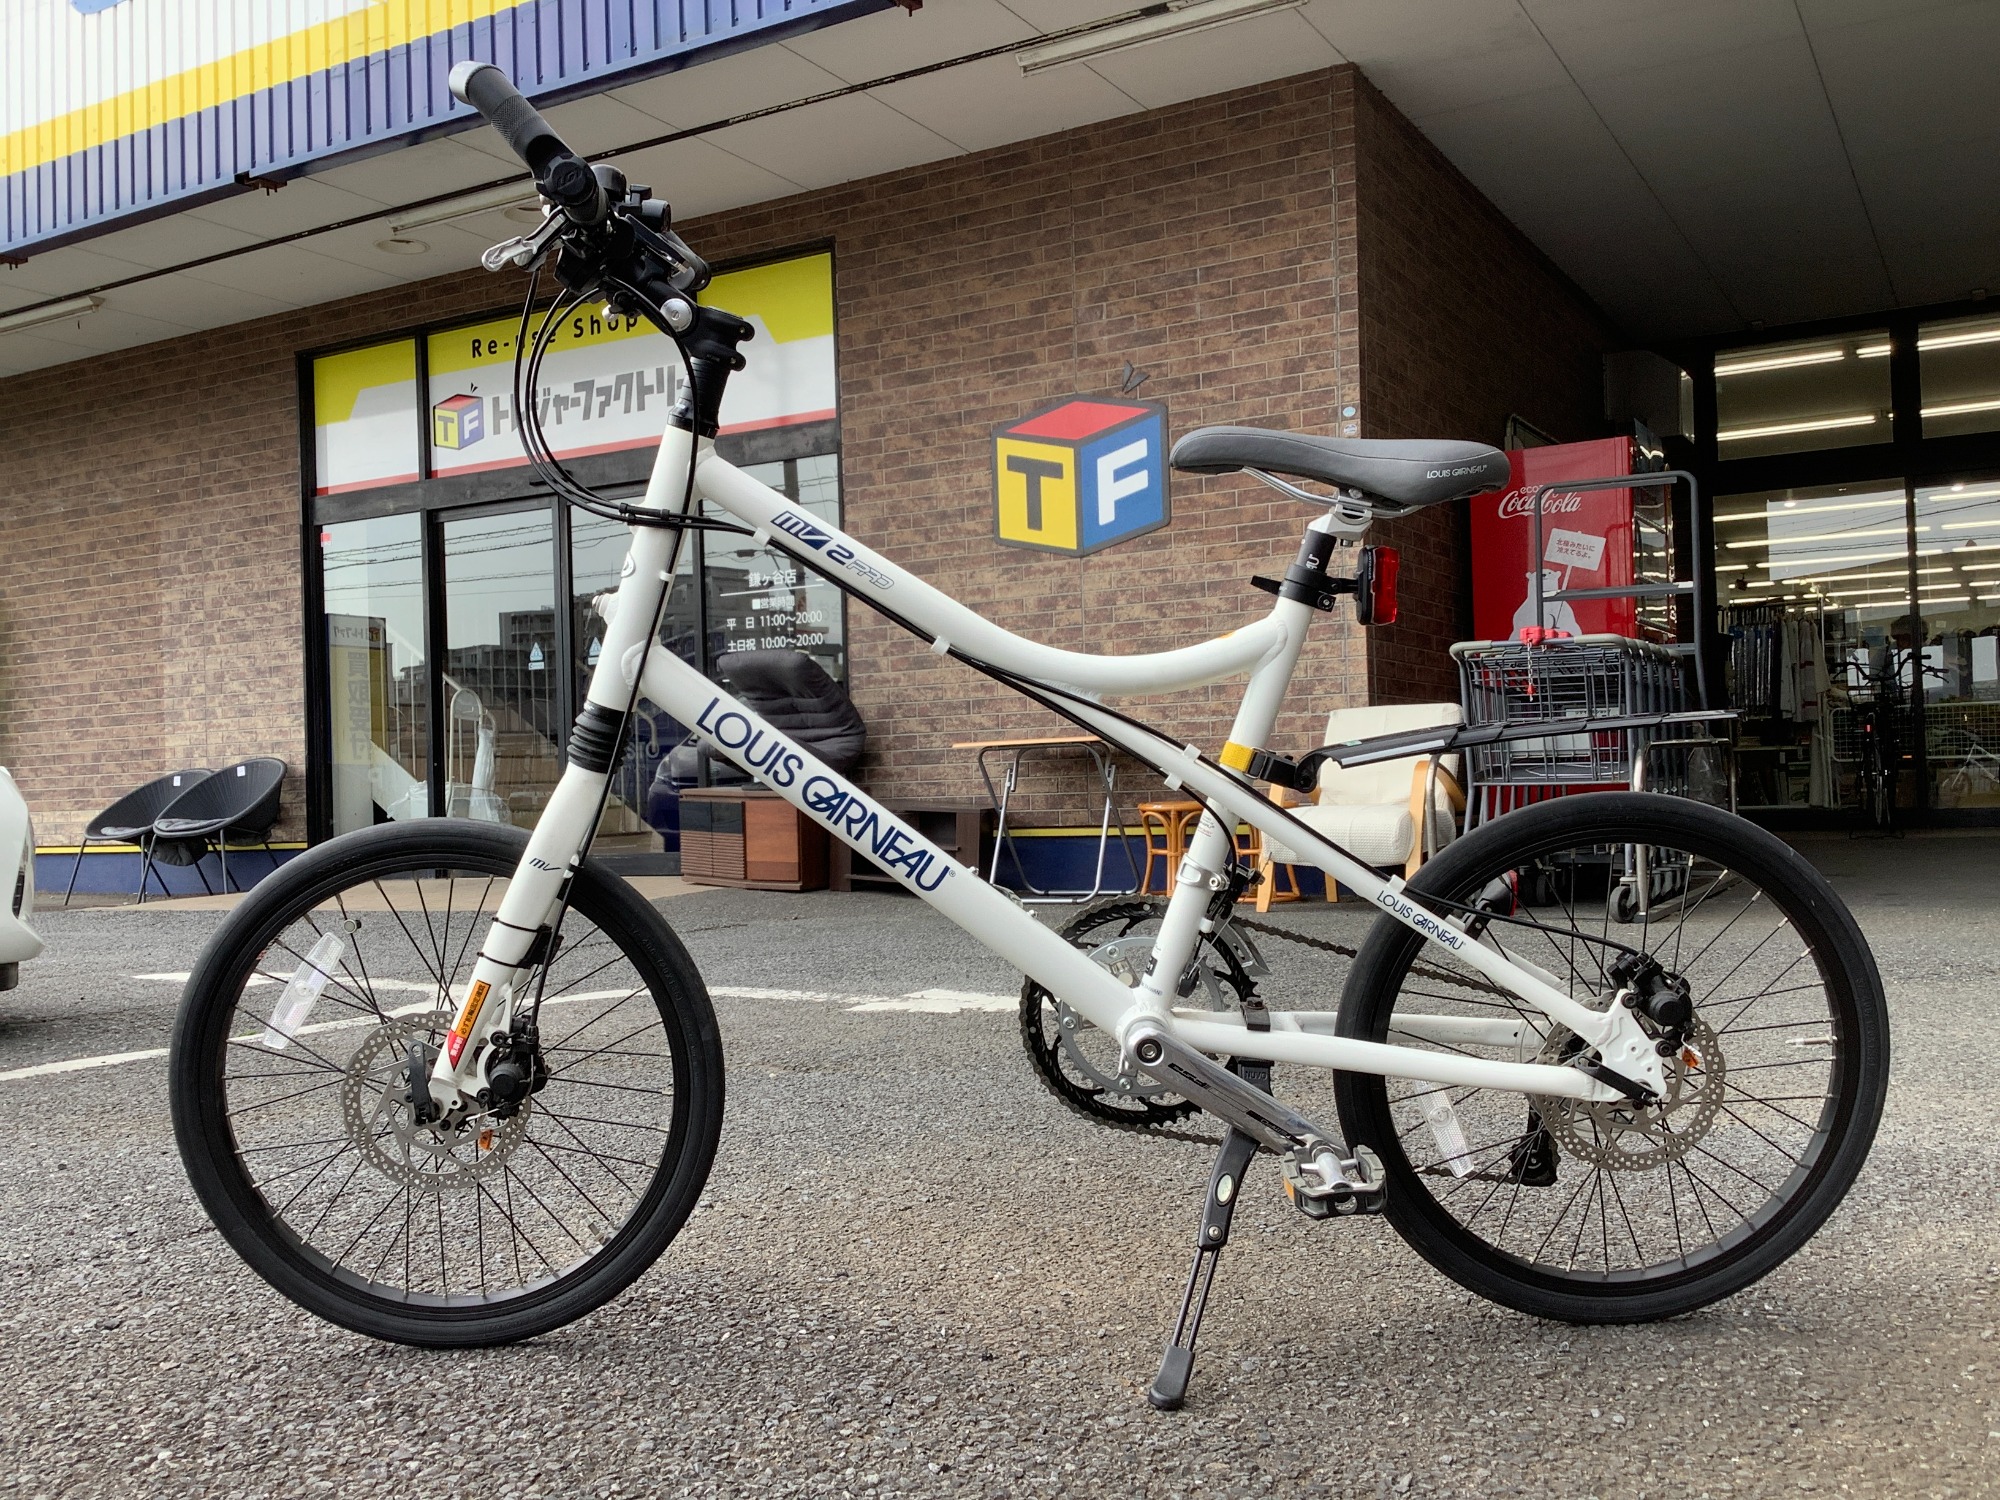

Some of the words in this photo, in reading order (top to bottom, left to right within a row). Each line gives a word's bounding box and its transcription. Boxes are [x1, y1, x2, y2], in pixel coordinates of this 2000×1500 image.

[472, 328, 556, 358] Re-se
[573, 315, 638, 339] Shop
[438, 409, 479, 442] TF
[1006, 438, 1149, 532] TF
[1427, 469, 1451, 479] LOUIS
[1452, 465, 1486, 477] GARNEAU
[1498, 488, 1582, 519] CocaCola
[727, 639, 756, 653] 土日祝
[695, 696, 804, 788] LOUIS
[801, 775, 951, 892] GARNEAU
[1376, 890, 1413, 919] LOUIS
[1412, 913, 1464, 950] GARNEAU
